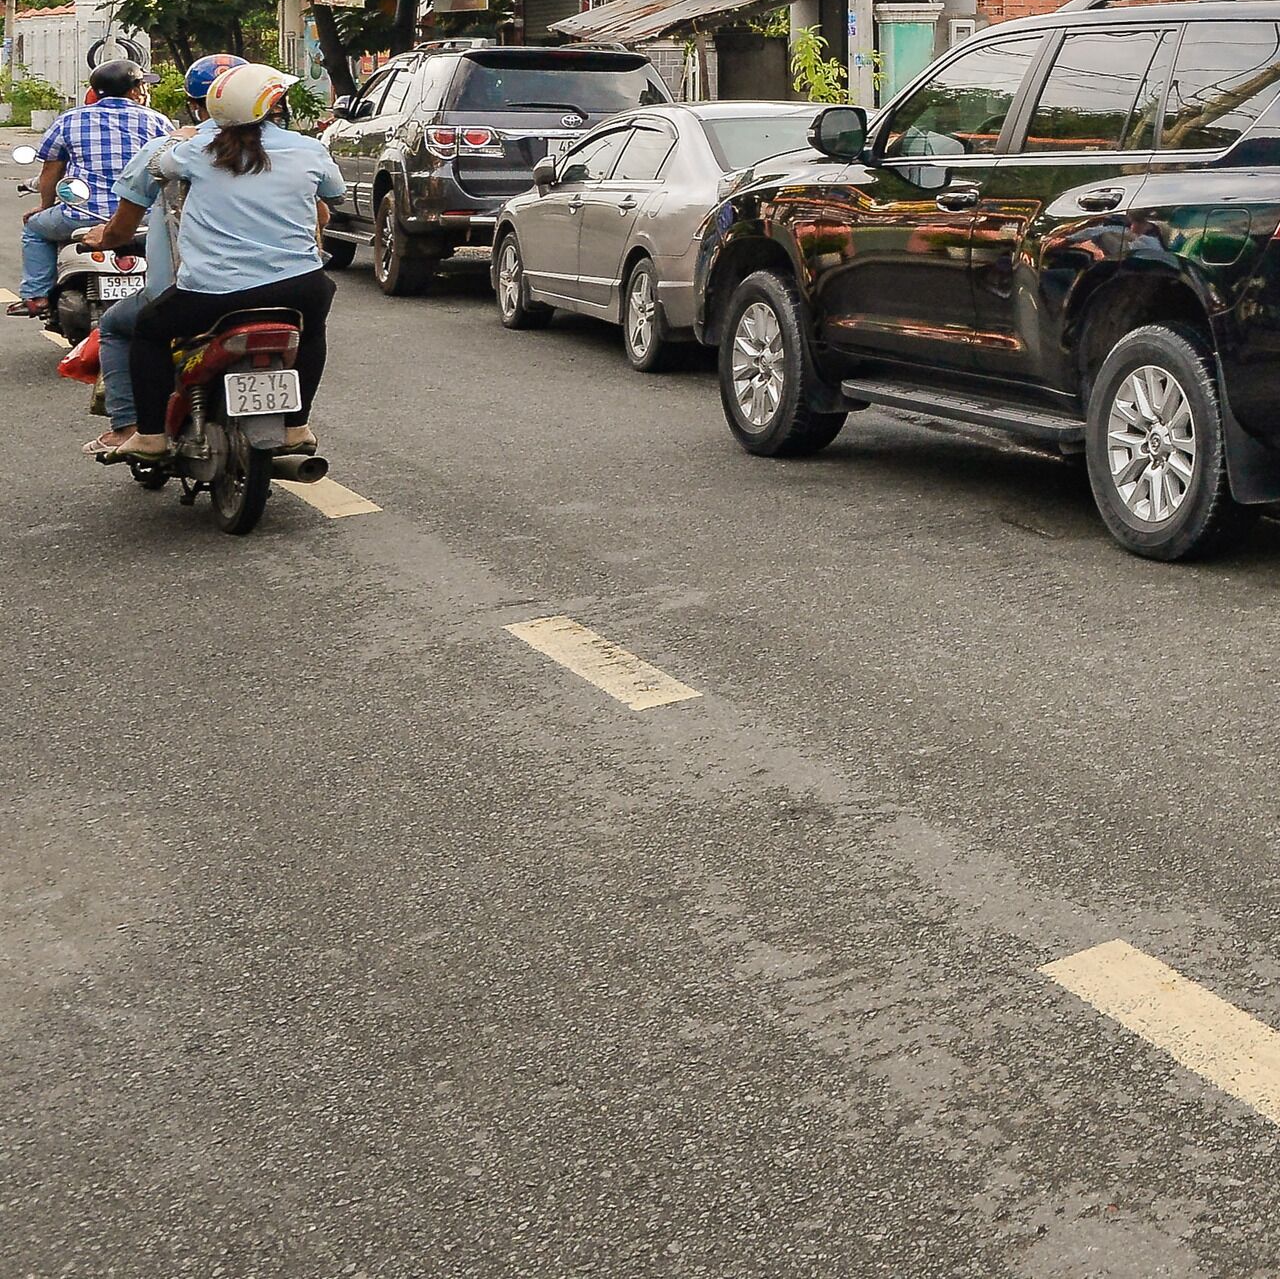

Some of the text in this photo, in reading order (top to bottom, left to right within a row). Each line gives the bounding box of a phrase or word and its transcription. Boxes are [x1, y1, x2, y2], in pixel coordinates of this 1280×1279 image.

[107, 276, 142, 287] 59-L2
[236, 375, 288, 393] 52-Y4
[238, 393, 290, 413] 2582
